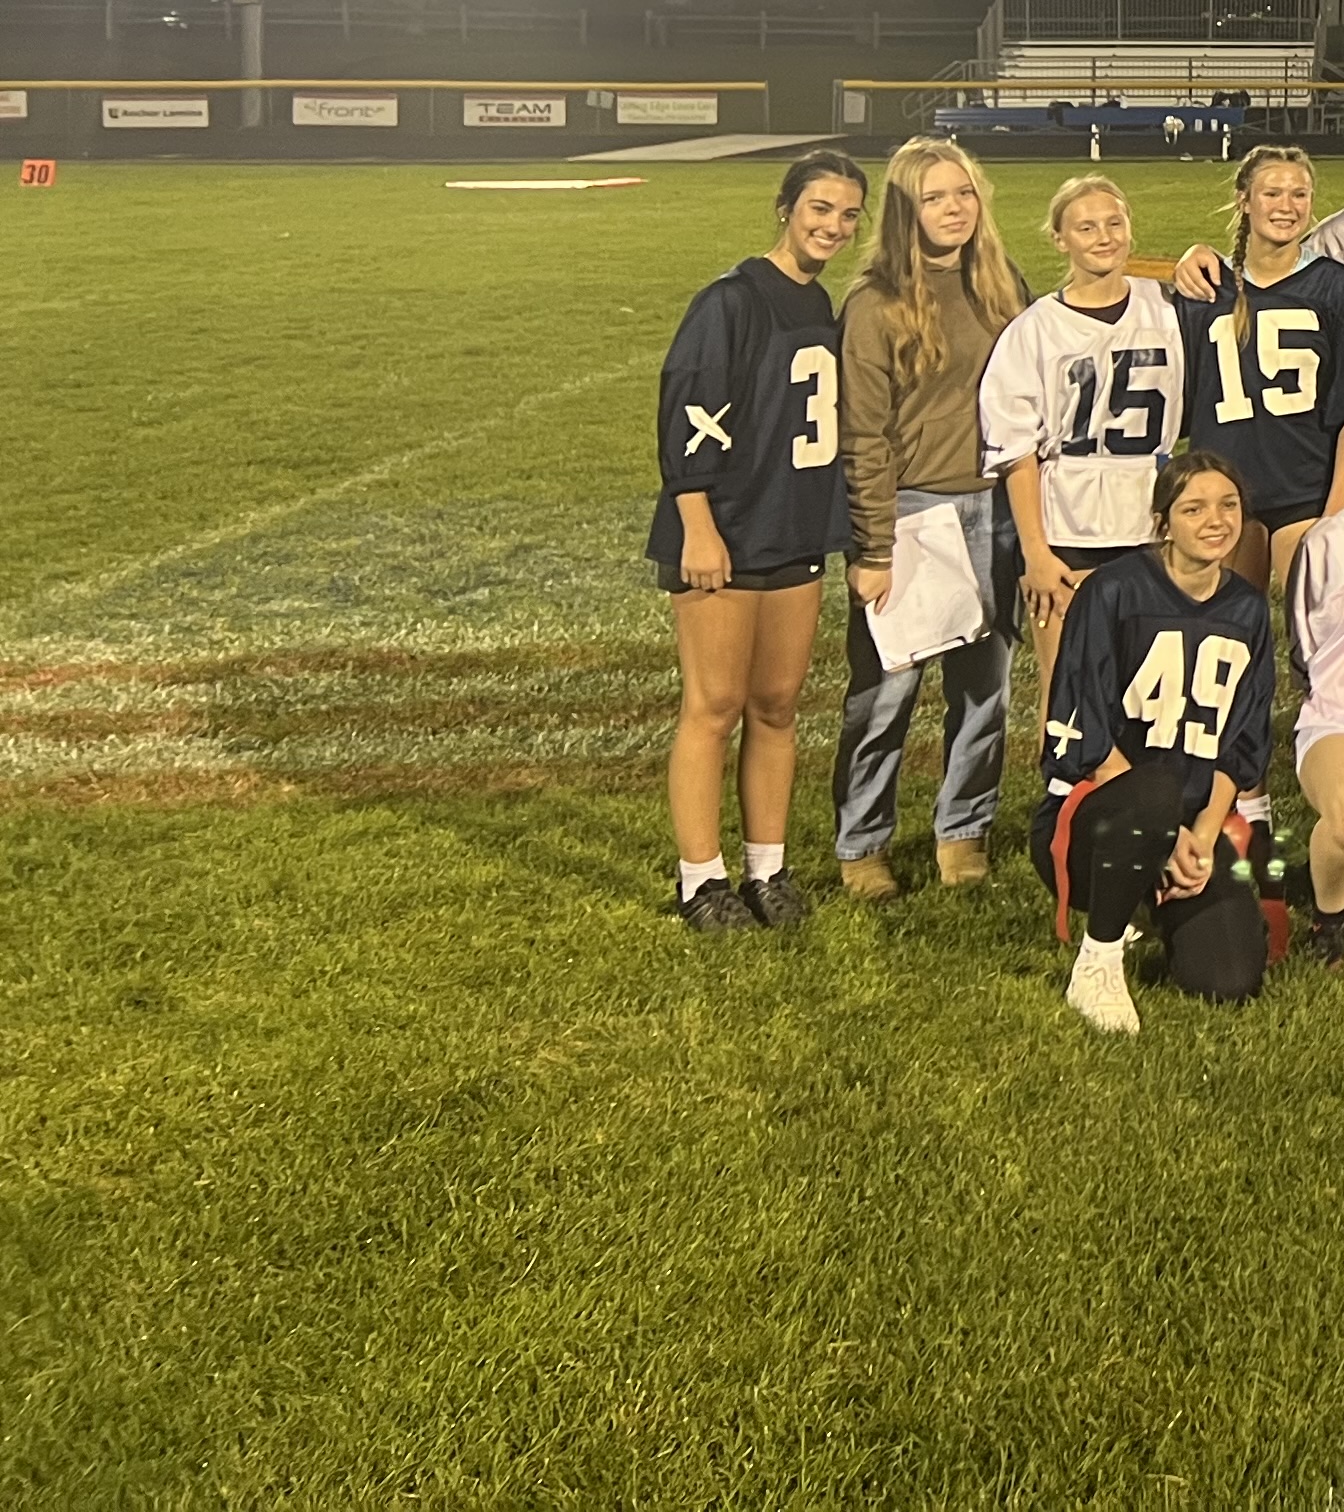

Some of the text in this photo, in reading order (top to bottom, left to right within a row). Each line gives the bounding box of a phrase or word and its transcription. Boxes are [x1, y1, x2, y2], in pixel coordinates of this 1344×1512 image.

[477, 103, 551, 114] TEAM
[24, 165, 49, 183] 30
[790, 345, 838, 469] 3
[1061, 348, 1168, 455] 15
[1209, 309, 1320, 423] 15
[1122, 630, 1250, 759] 49
